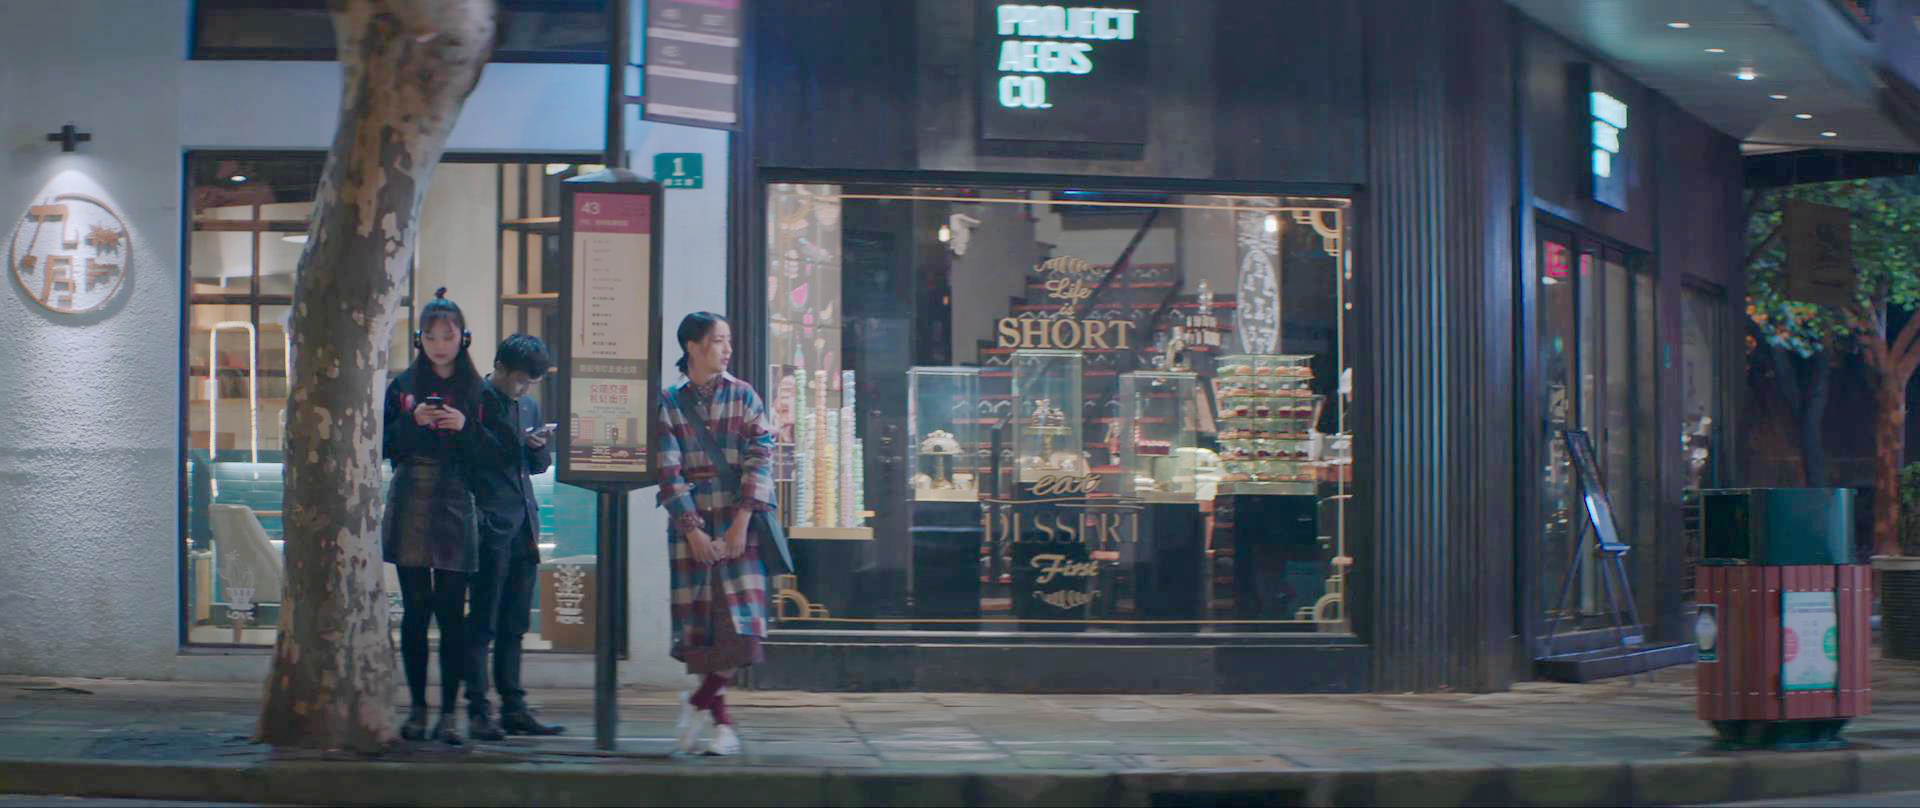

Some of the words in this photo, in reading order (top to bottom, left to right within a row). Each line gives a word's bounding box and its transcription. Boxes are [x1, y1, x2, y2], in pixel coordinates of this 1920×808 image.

[997, 4, 1140, 40] PROJECT
[998, 40, 1094, 75] AEGIS
[998, 75, 1053, 108] CO.
[672, 156, 687, 176] 1
[580, 201, 600, 215] 43
[1045, 277, 1092, 305] Life
[998, 317, 1137, 350] SHORT
[1026, 473, 1102, 496] eat
[1030, 553, 1101, 584] First
